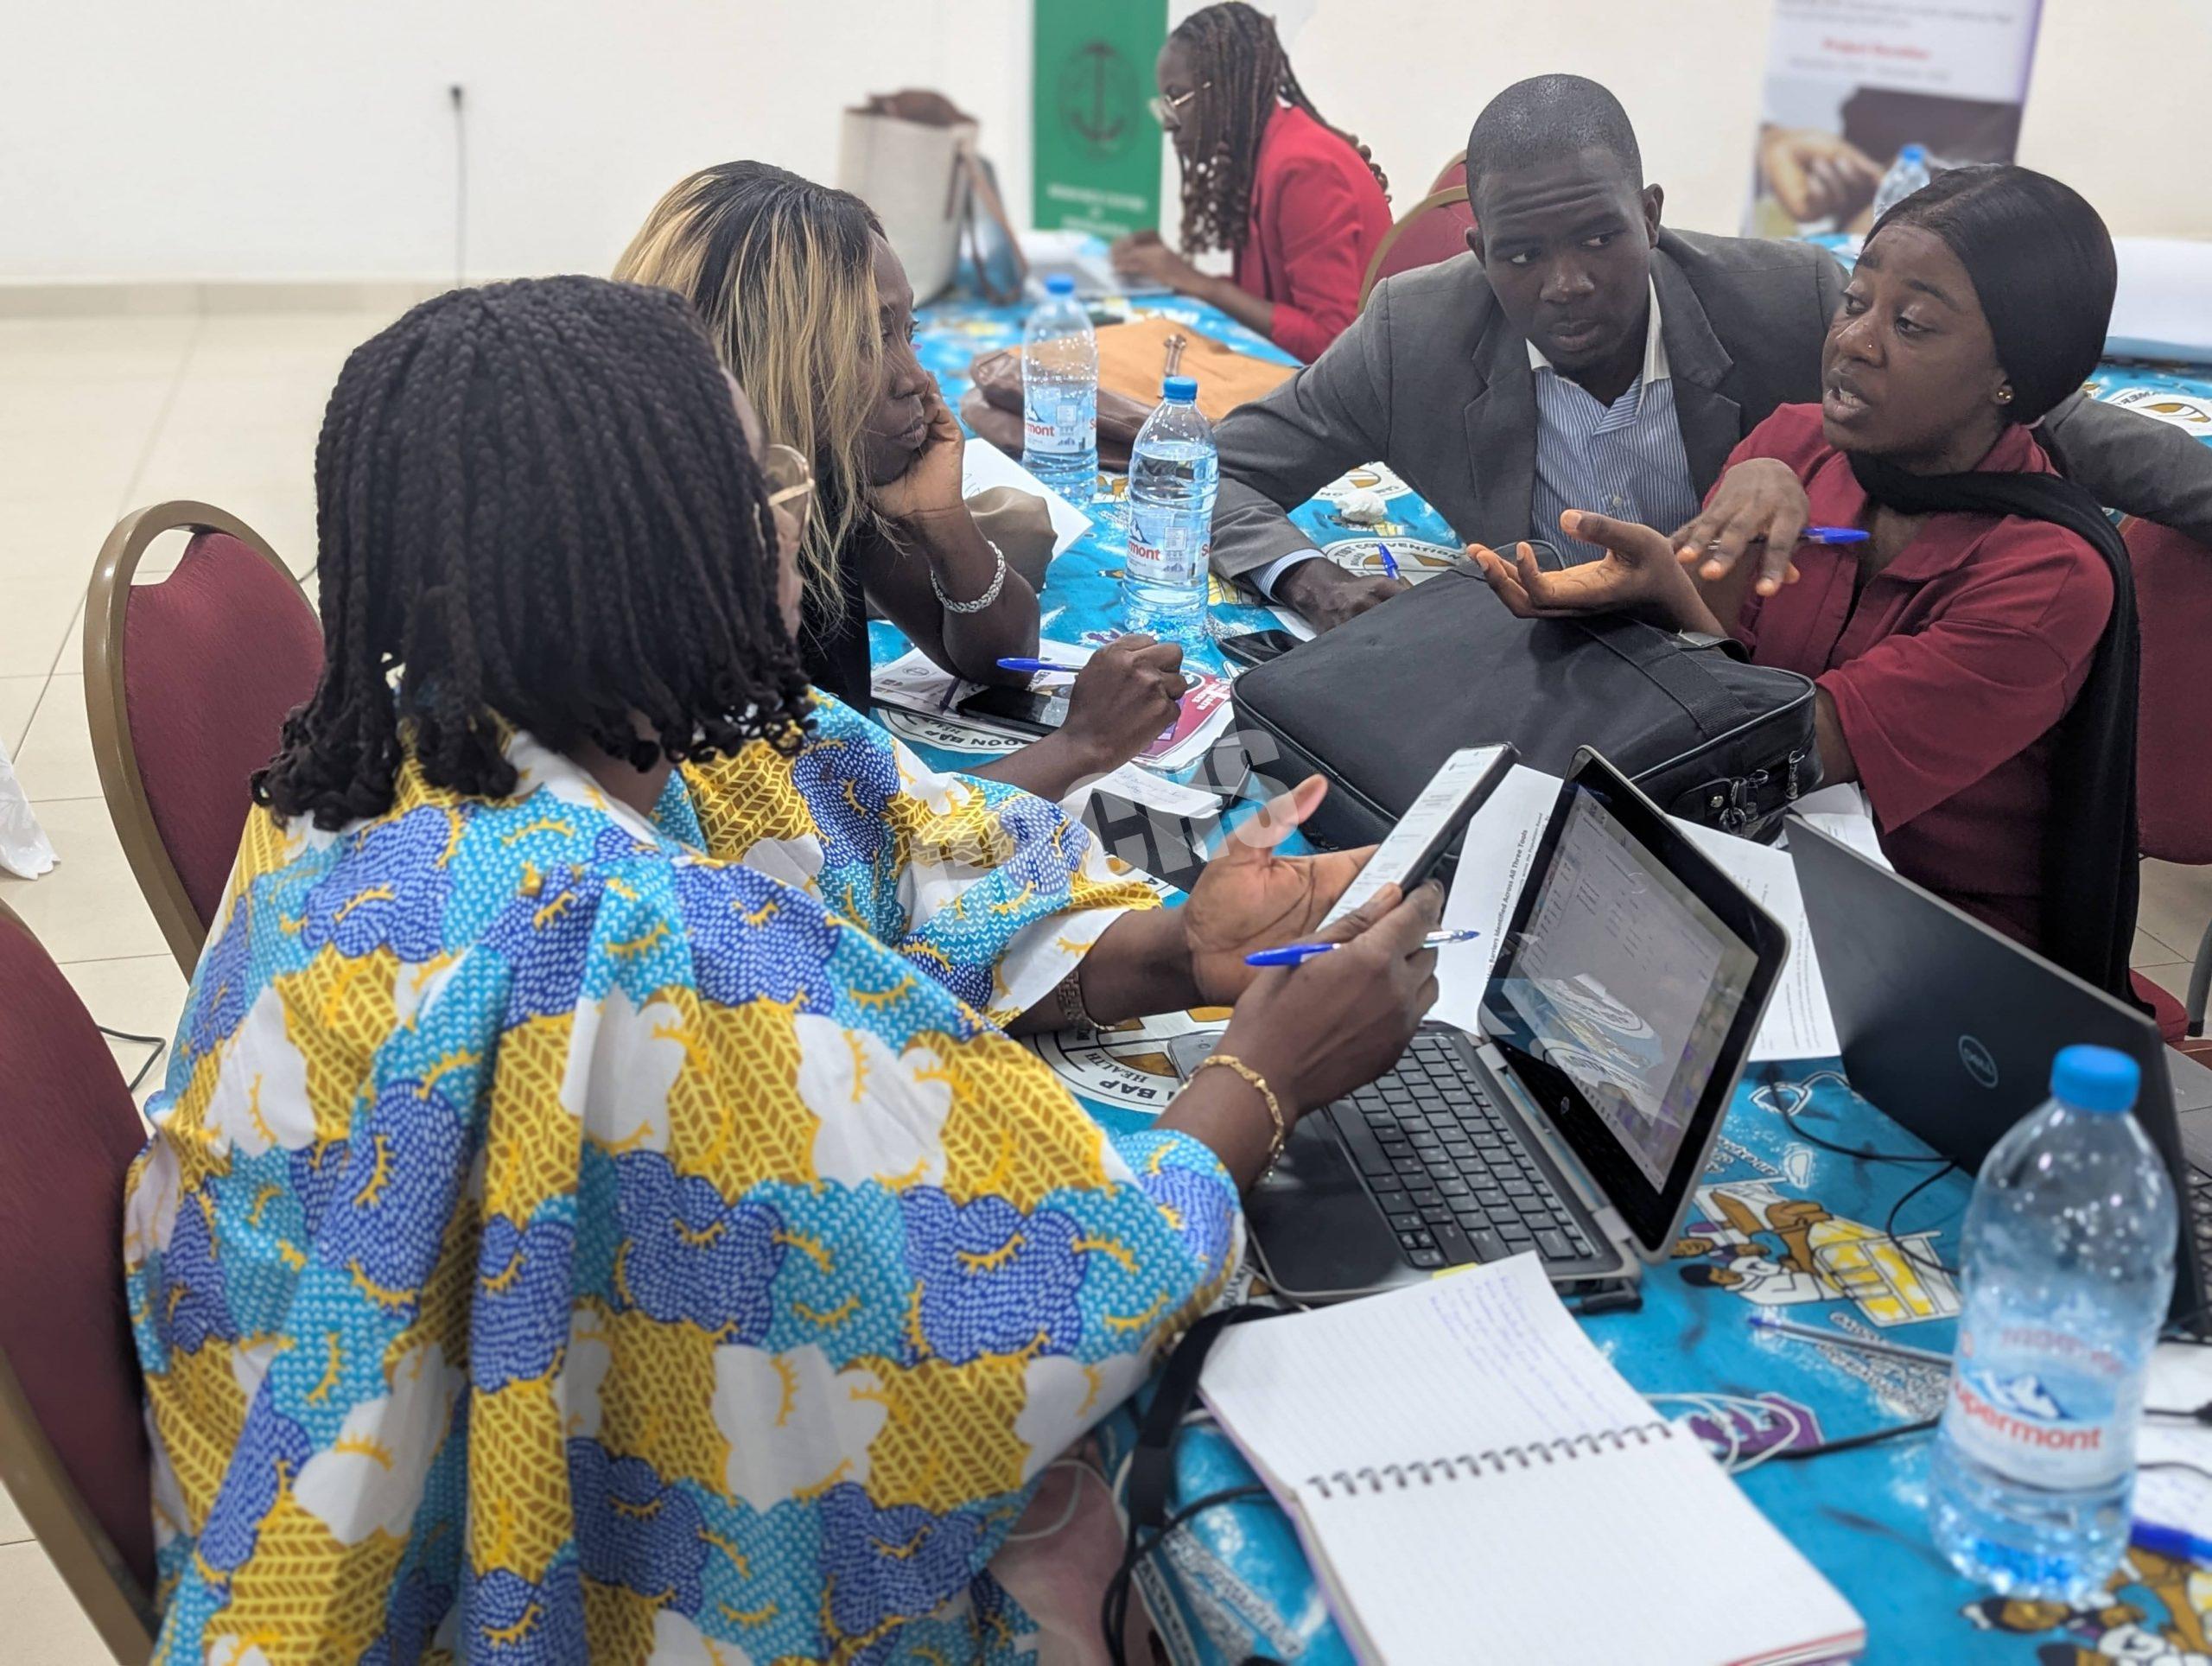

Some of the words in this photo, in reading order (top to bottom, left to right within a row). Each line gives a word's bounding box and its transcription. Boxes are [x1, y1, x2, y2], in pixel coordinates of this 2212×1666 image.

[1129, 540, 1160, 561] rmont
[1489, 937, 1500, 963] Barriers
[1495, 902, 1509, 936] Identified
[1503, 880, 1514, 903] Across
[1512, 848, 1522, 868] Three
[1518, 830, 1528, 848] Tools
[1084, 1052, 1150, 1084] HEALTH
[1099, 1080, 1158, 1099] BAP
[1955, 1380, 2102, 1451] upermont
